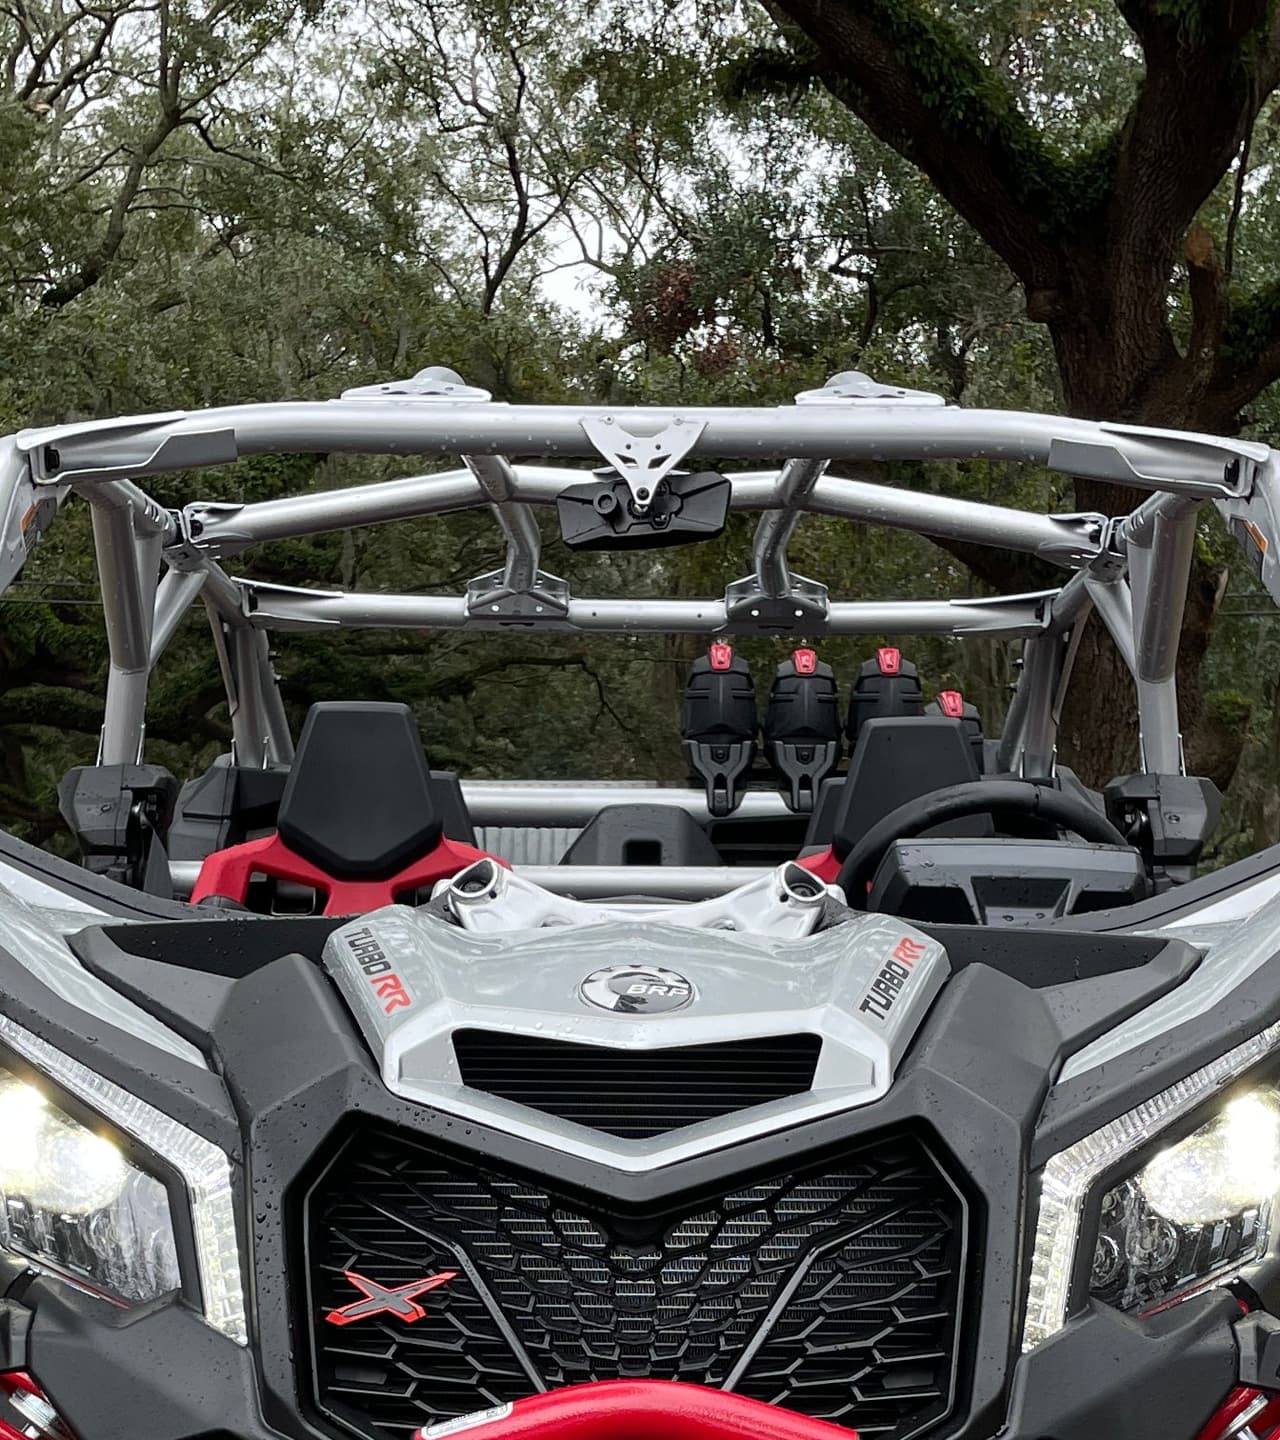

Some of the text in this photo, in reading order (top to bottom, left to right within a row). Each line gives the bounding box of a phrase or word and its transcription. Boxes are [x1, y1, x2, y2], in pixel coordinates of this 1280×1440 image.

[344, 927, 412, 1015] TURBO RR
[626, 983, 689, 997] BRP
[859, 937, 926, 1021] TURBO RR
